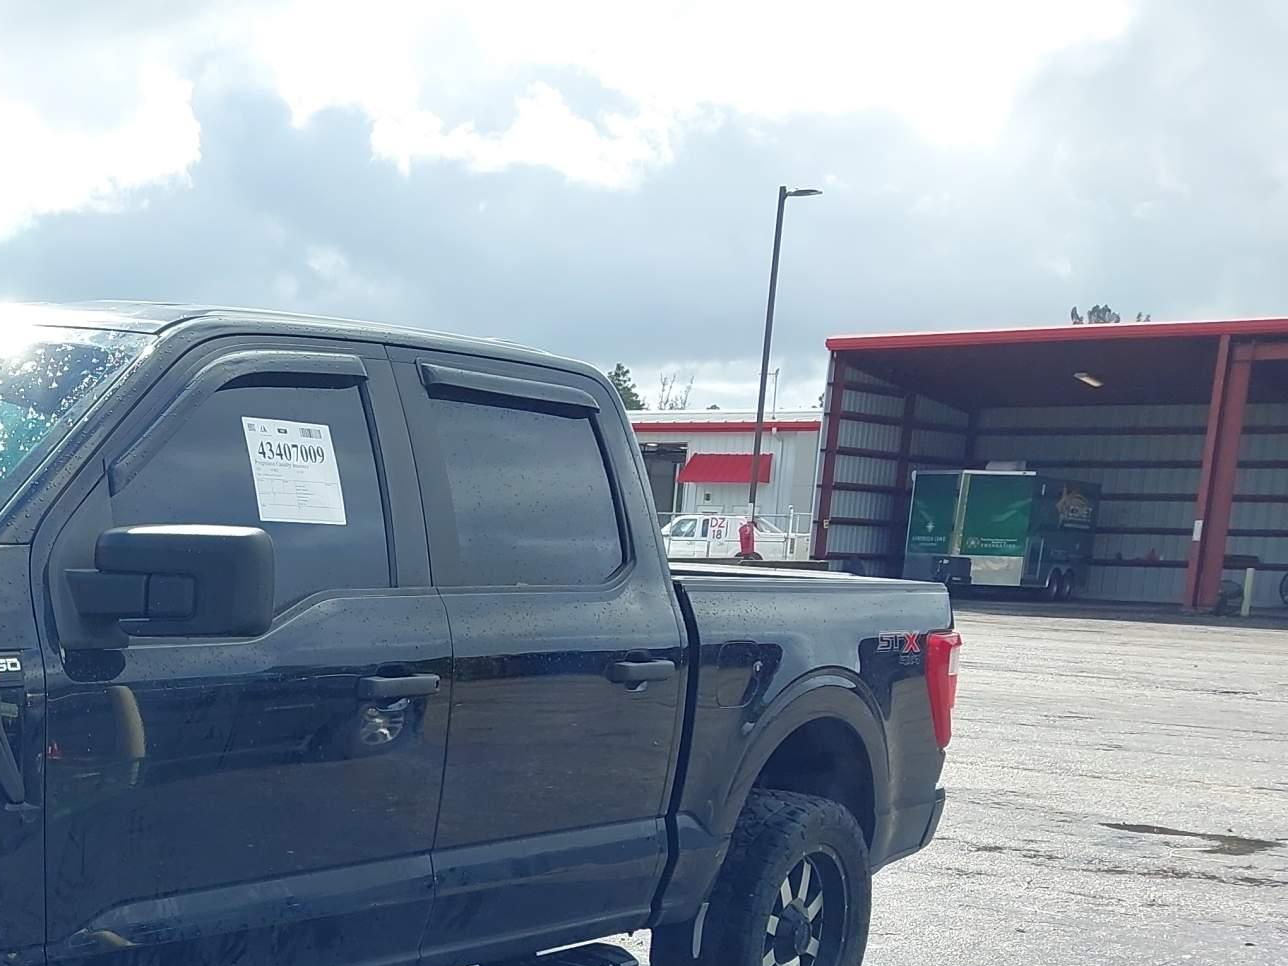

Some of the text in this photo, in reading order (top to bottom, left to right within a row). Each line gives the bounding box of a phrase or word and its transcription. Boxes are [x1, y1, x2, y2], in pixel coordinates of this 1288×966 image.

[257, 441, 325, 464] 43407009
[710, 517, 726, 528] DZ
[712, 529, 723, 540] 18
[877, 631, 920, 653] STX
